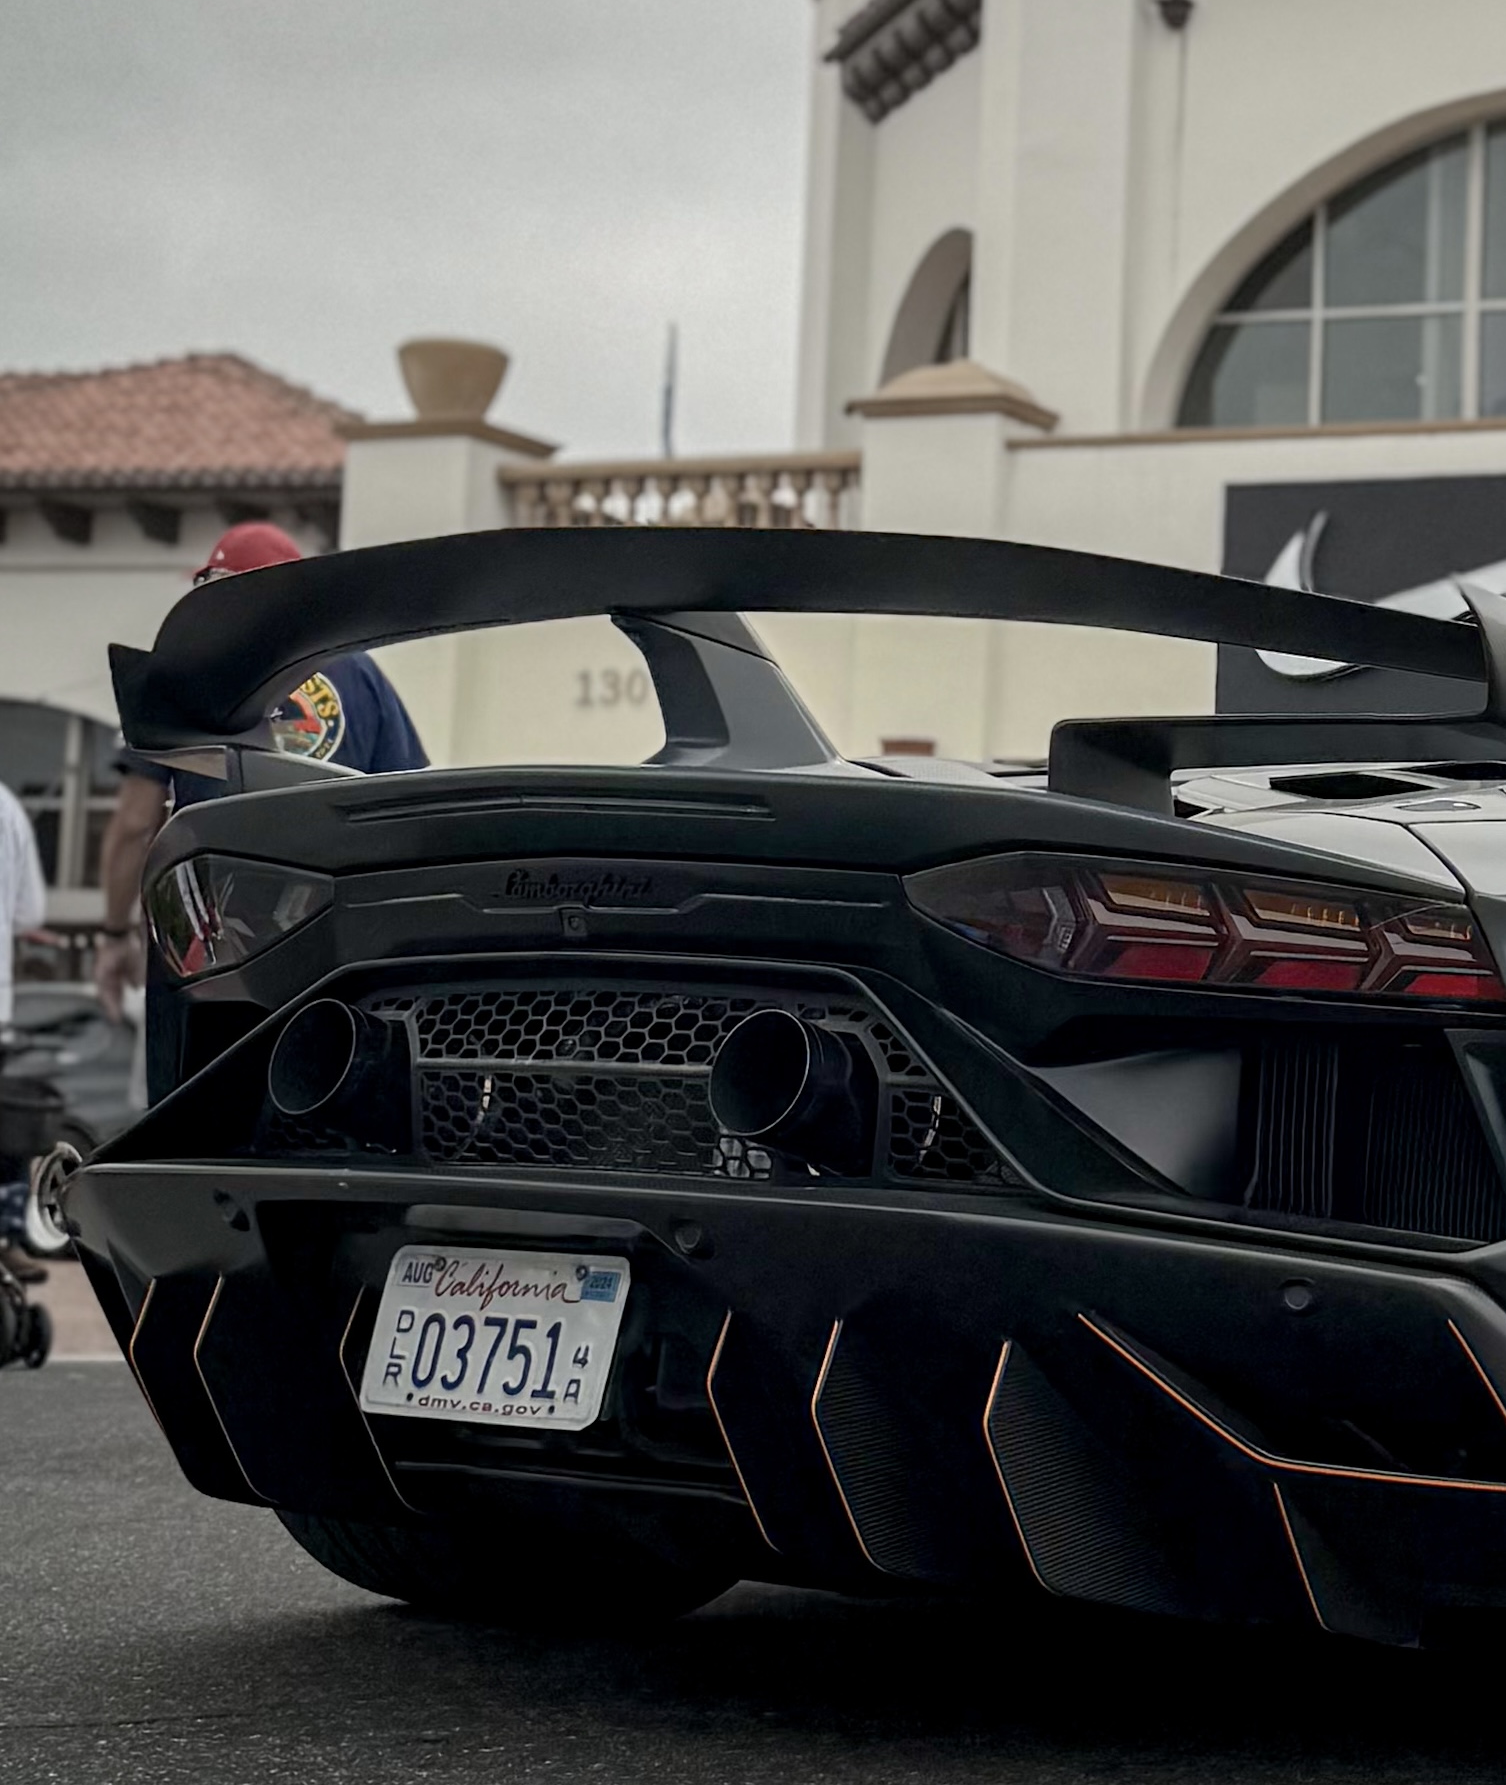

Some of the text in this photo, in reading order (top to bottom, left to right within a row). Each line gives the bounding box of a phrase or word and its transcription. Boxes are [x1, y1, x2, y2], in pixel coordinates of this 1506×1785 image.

[402, 1261, 434, 1284] AUG
[434, 1260, 581, 1311] California
[411, 1312, 563, 1400] 03751
[418, 1394, 542, 1416] dmv.ca.gov
